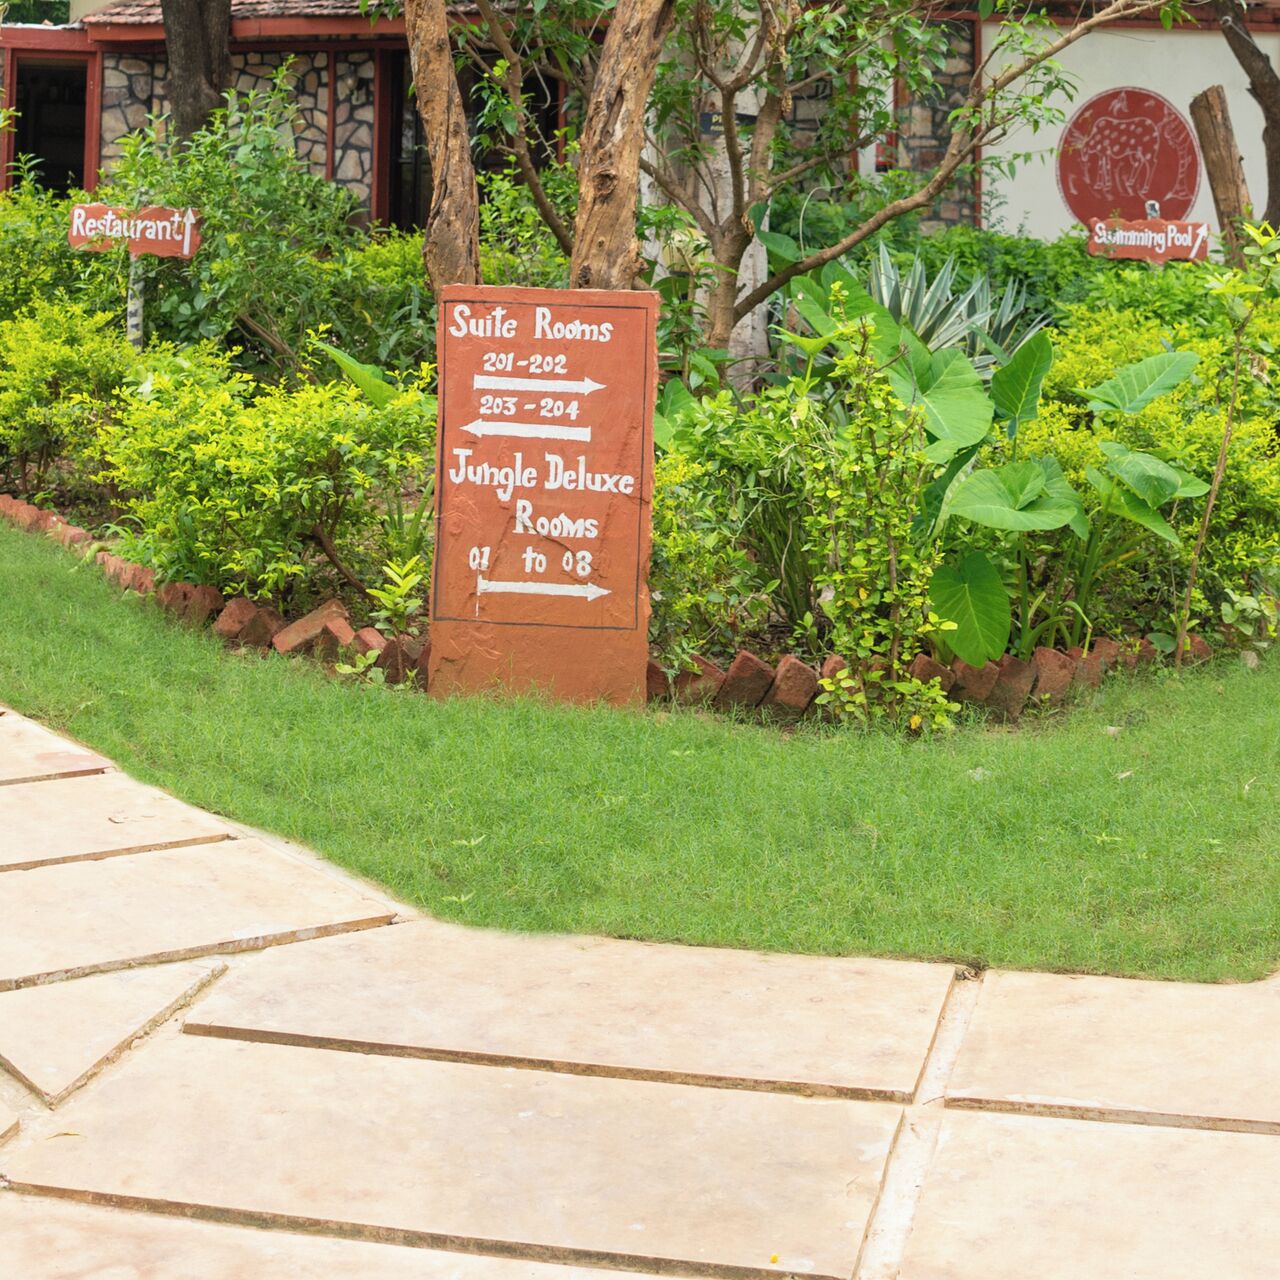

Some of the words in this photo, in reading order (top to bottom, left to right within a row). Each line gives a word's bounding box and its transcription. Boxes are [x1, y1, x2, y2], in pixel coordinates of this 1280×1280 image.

[72, 207, 184, 241] Restaurant
[1167, 224, 1193, 248] Pool
[448, 303, 518, 339] Suite
[533, 306, 614, 343] Rooms
[448, 447, 538, 502] Jungle
[543, 451, 635, 495] Deluxe
[512, 498, 599, 539] Rooms
[468, 545, 491, 571] 01
[521, 545, 548, 574] to
[561, 550, 593, 577] 08
